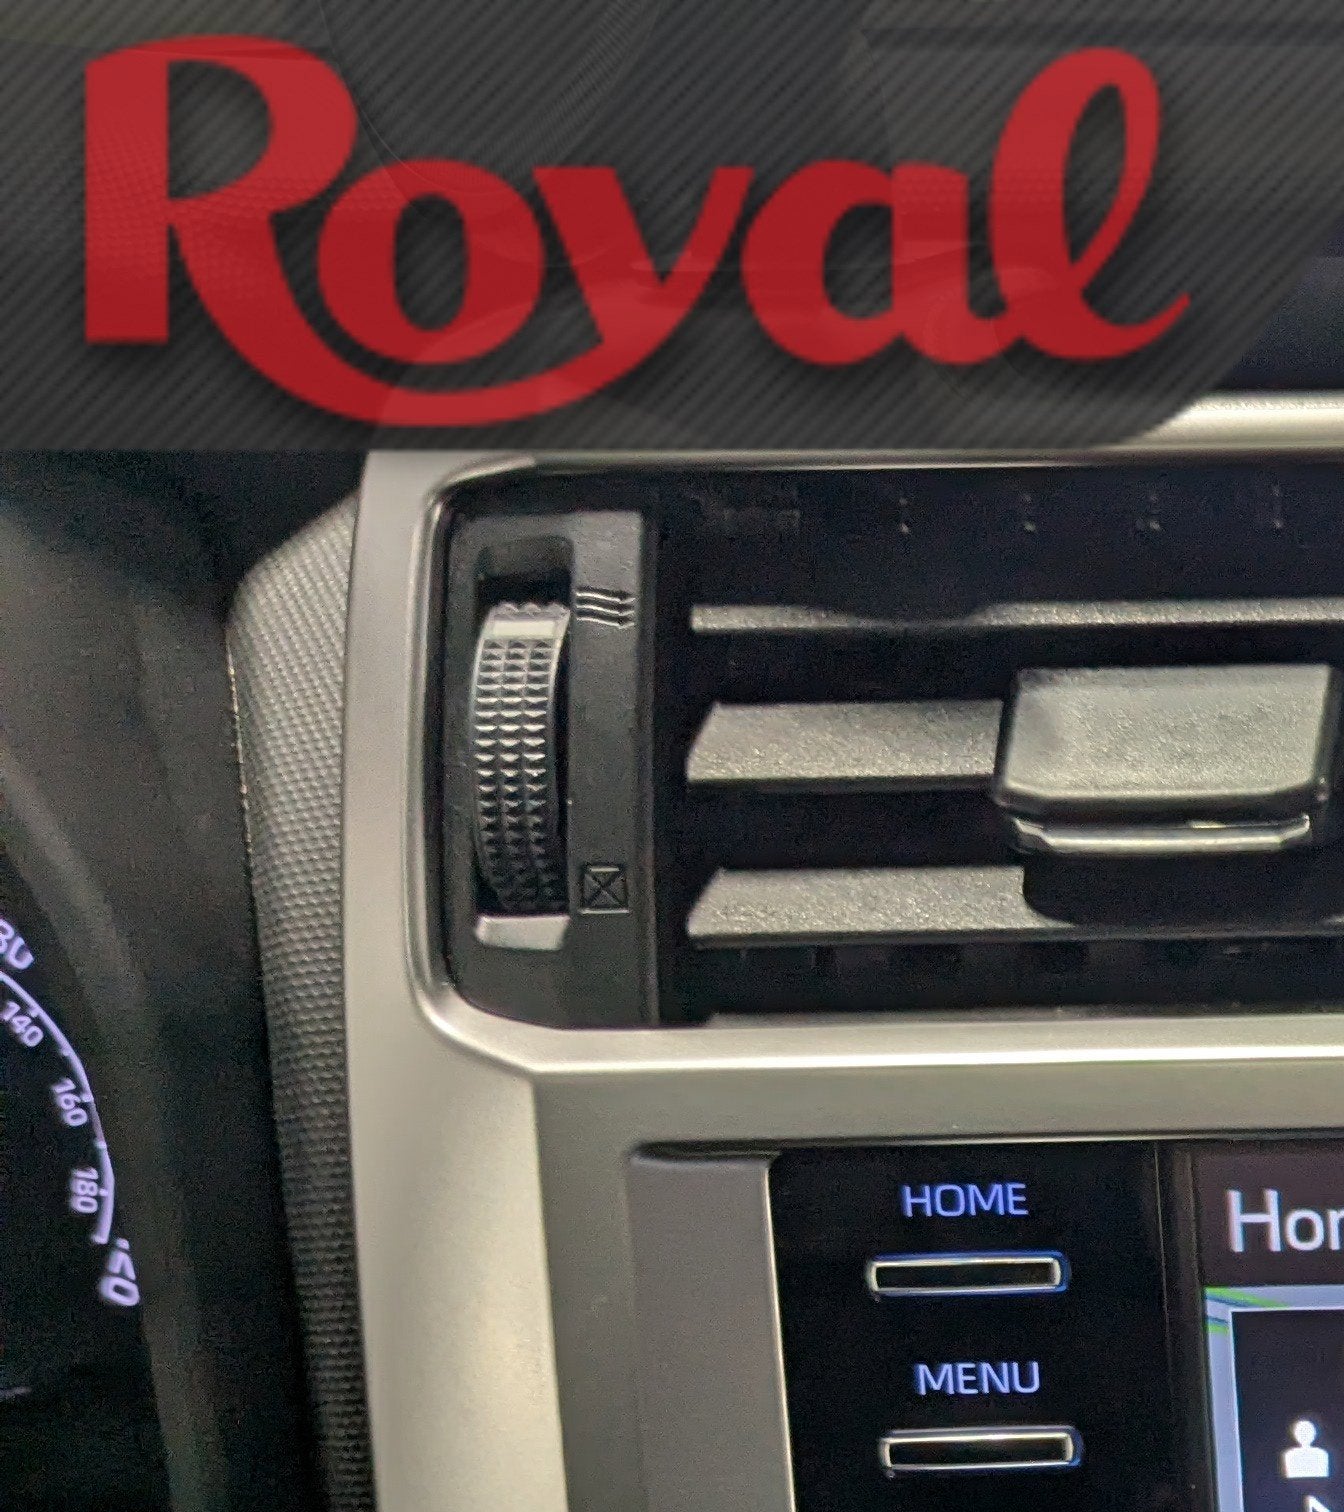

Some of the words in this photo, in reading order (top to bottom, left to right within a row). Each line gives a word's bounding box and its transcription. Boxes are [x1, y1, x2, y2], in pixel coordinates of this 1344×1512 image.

[1, 1001, 44, 1047] 140
[52, 1077, 87, 1127] 160
[70, 1166, 99, 1214] 180
[902, 1182, 1029, 1217] HOME
[913, 1360, 1041, 1396] MENU
